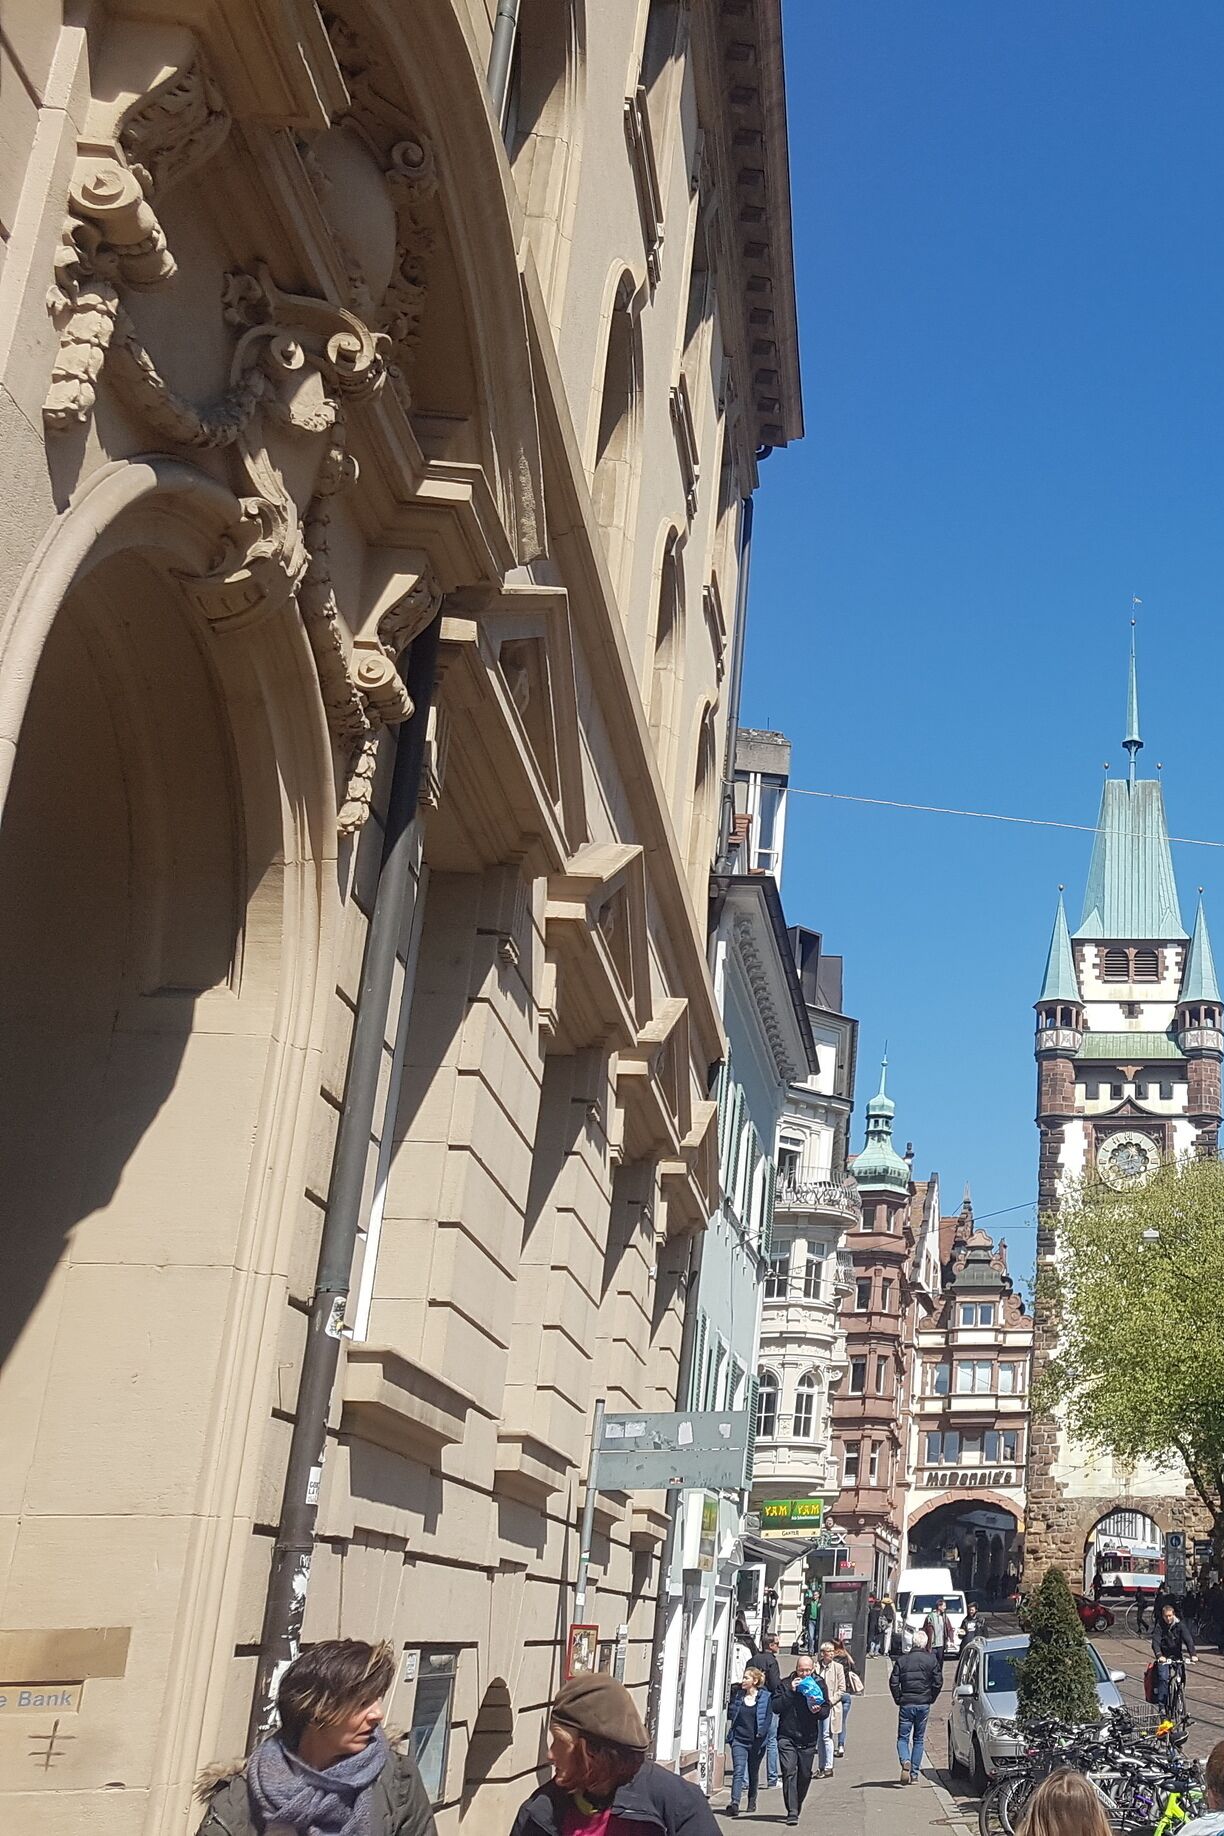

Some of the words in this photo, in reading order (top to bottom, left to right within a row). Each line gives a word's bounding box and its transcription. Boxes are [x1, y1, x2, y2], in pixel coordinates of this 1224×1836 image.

[764, 1505, 788, 1517] YAM
[797, 1504, 820, 1516] YAM
[17, 1689, 73, 1707] Bank
